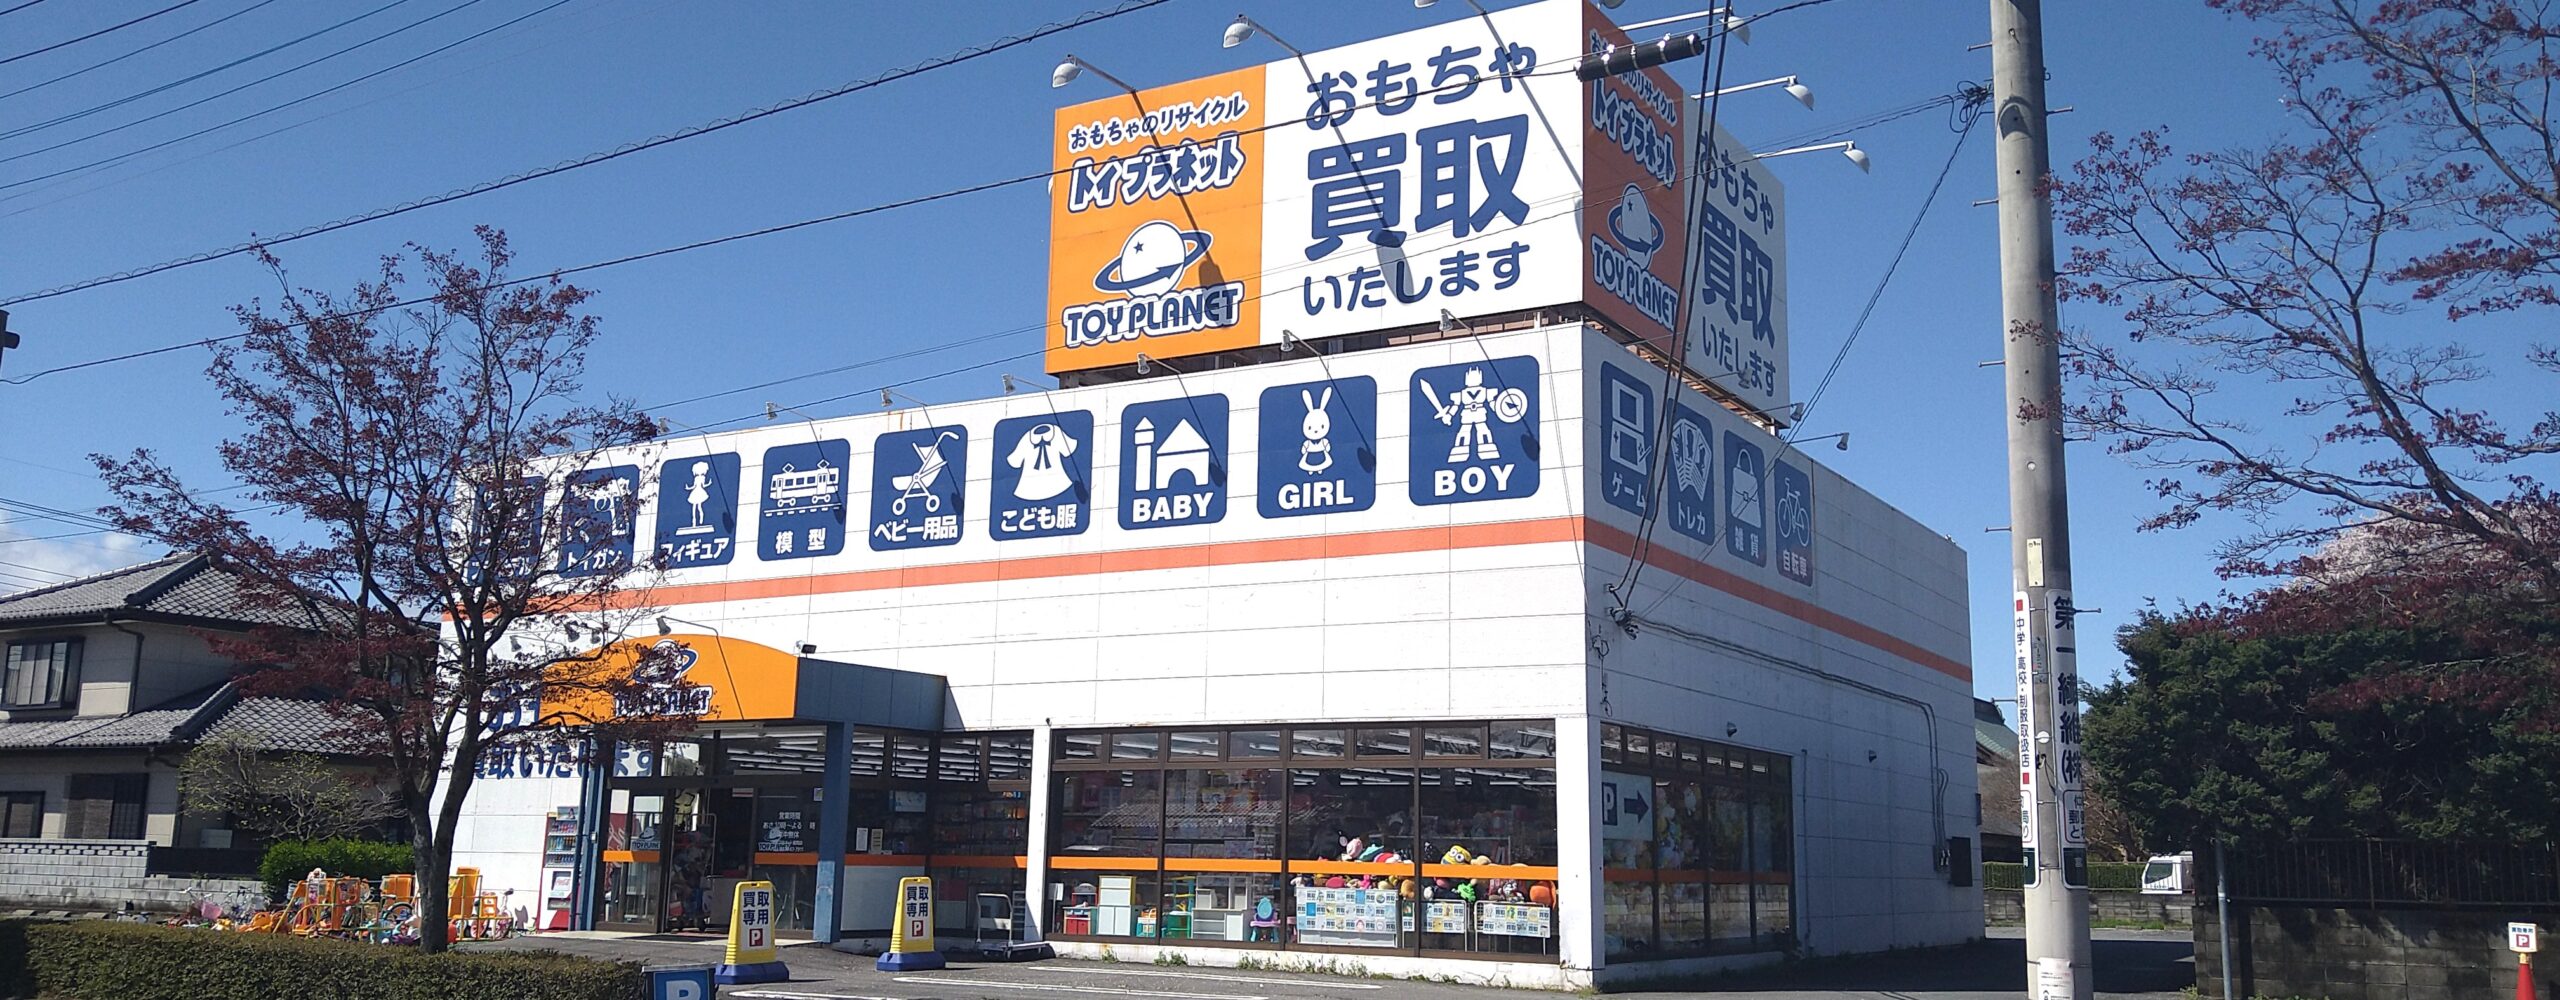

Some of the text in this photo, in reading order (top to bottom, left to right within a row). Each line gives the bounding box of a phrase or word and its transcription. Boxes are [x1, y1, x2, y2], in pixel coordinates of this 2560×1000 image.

[1306, 42, 1537, 131] おもちゃ
[1070, 95, 1247, 150] おもちゃのリサイクル
[1071, 134, 1243, 209] トイプラネット
[1304, 114, 1530, 262] 買取
[1701, 130, 1775, 235] おもちゃ
[1303, 241, 1530, 316] いたします
[1701, 200, 1775, 349] 買取
[1702, 315, 1776, 398] いたします
[1278, 480, 1354, 510] GIRL
[1434, 463, 1515, 497] BOY
[1612, 472, 1647, 509] ゲーム
[1000, 503, 1077, 533] こども服
[1132, 492, 1214, 523] BABY
[1678, 501, 1706, 536] トレカ
[774, 528, 826, 555] 模型
[874, 516, 959, 543] ベビー用品
[567, 549, 623, 573] トイガン
[663, 538, 729, 563] フィギュア
[1603, 785, 1615, 822] P
[743, 891, 770, 908] 買取
[906, 902, 929, 918] 専用
[907, 886, 929, 901] 買取
[743, 908, 770, 926] 専用
